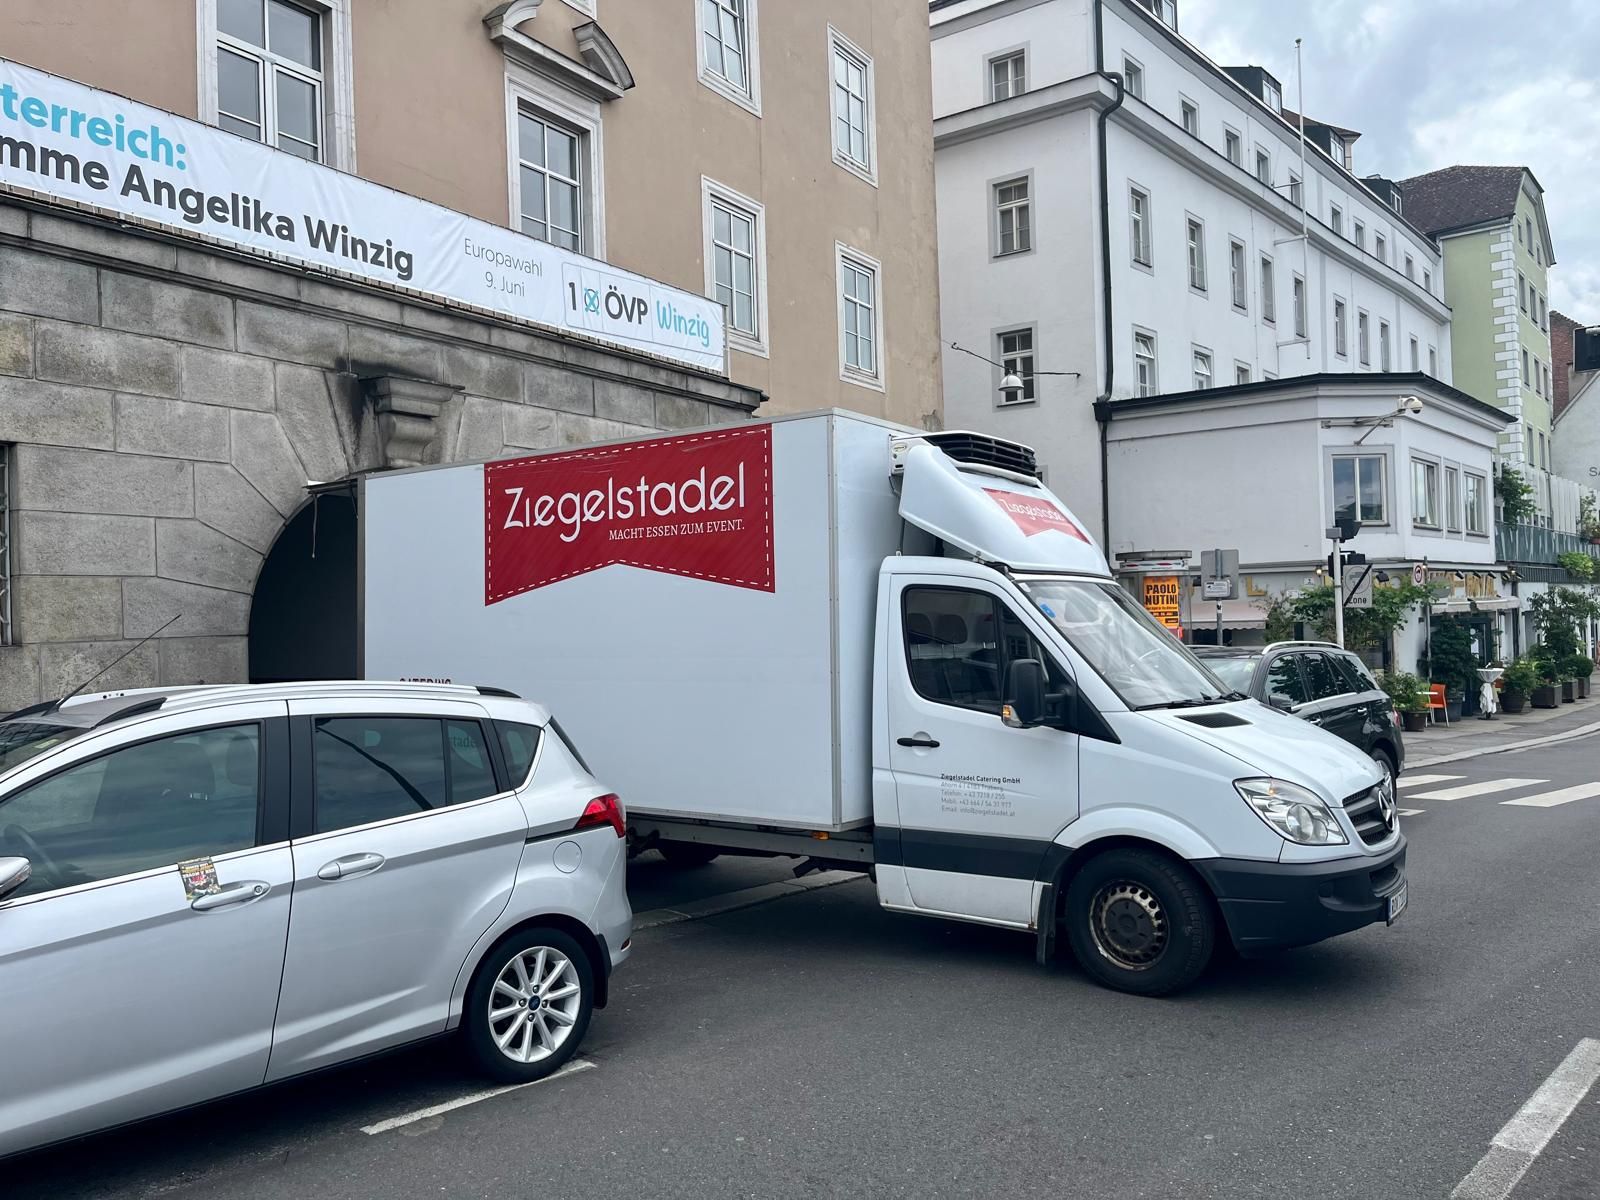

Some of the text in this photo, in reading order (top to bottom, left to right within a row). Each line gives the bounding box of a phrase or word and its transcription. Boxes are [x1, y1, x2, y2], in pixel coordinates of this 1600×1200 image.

[0, 83, 187, 171] terreich:
[0, 134, 413, 281] mme Angelika Winzig
[464, 238, 543, 277] Europawahl
[484, 271, 525, 297] 9. Juni
[568, 282, 709, 348] 1 ÖVP Winzig
[503, 461, 745, 543] Ziegelstadel
[608, 519, 745, 541] MACHT ESSEN ZUM EVENT.
[1145, 595, 1177, 605] NUTINI
[1146, 584, 1177, 594] PAOLO
[941, 773, 975, 782] Ziegelstadel
[976, 775, 1001, 784] Catering
